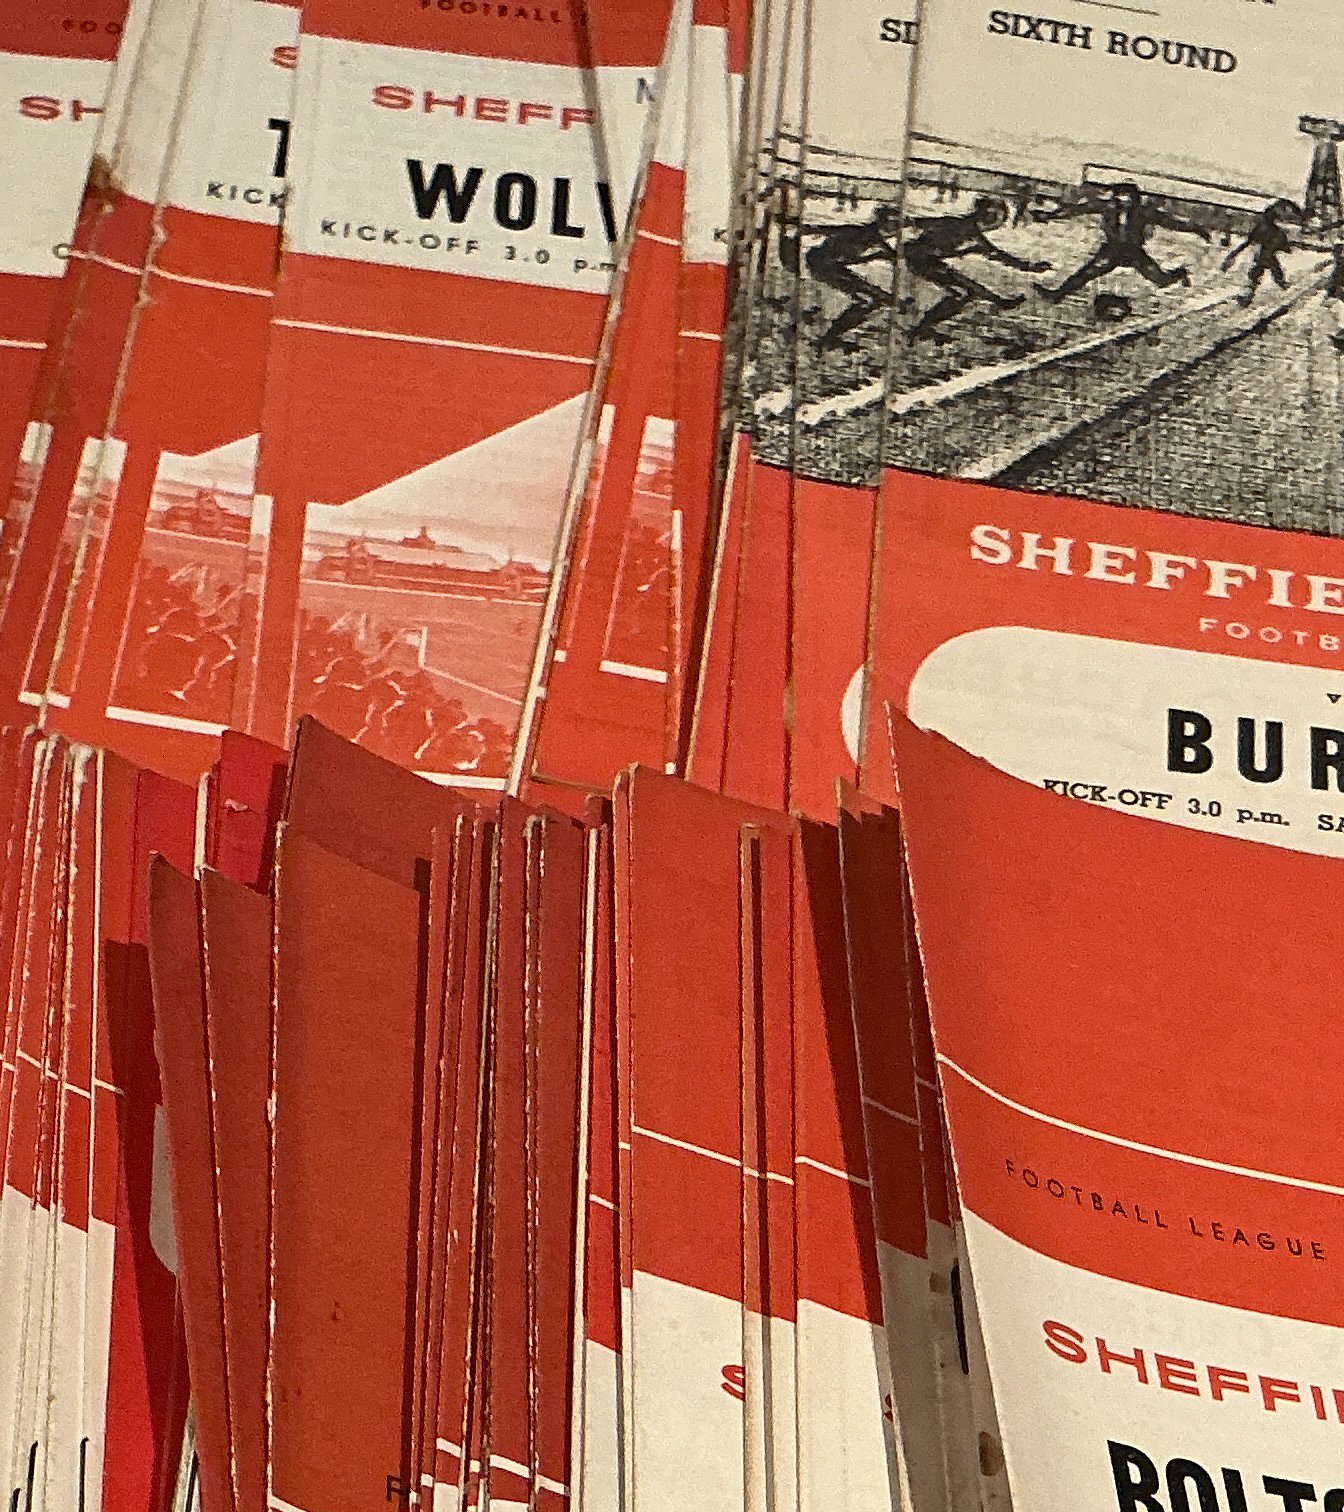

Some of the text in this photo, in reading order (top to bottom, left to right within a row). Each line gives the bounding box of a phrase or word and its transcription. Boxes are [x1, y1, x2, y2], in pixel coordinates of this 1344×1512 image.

[988, 10, 1237, 74] SIXTH ROUND
[320, 220, 480, 254] KICK-OFF
[504, 245, 550, 265] 3.0
[1188, 798, 1222, 819] 3.0
[1236, 805, 1290, 828] p.m.
[1006, 1159, 1168, 1229] FOOTBALL
[1189, 1217, 1324, 1261] LEAGUE
